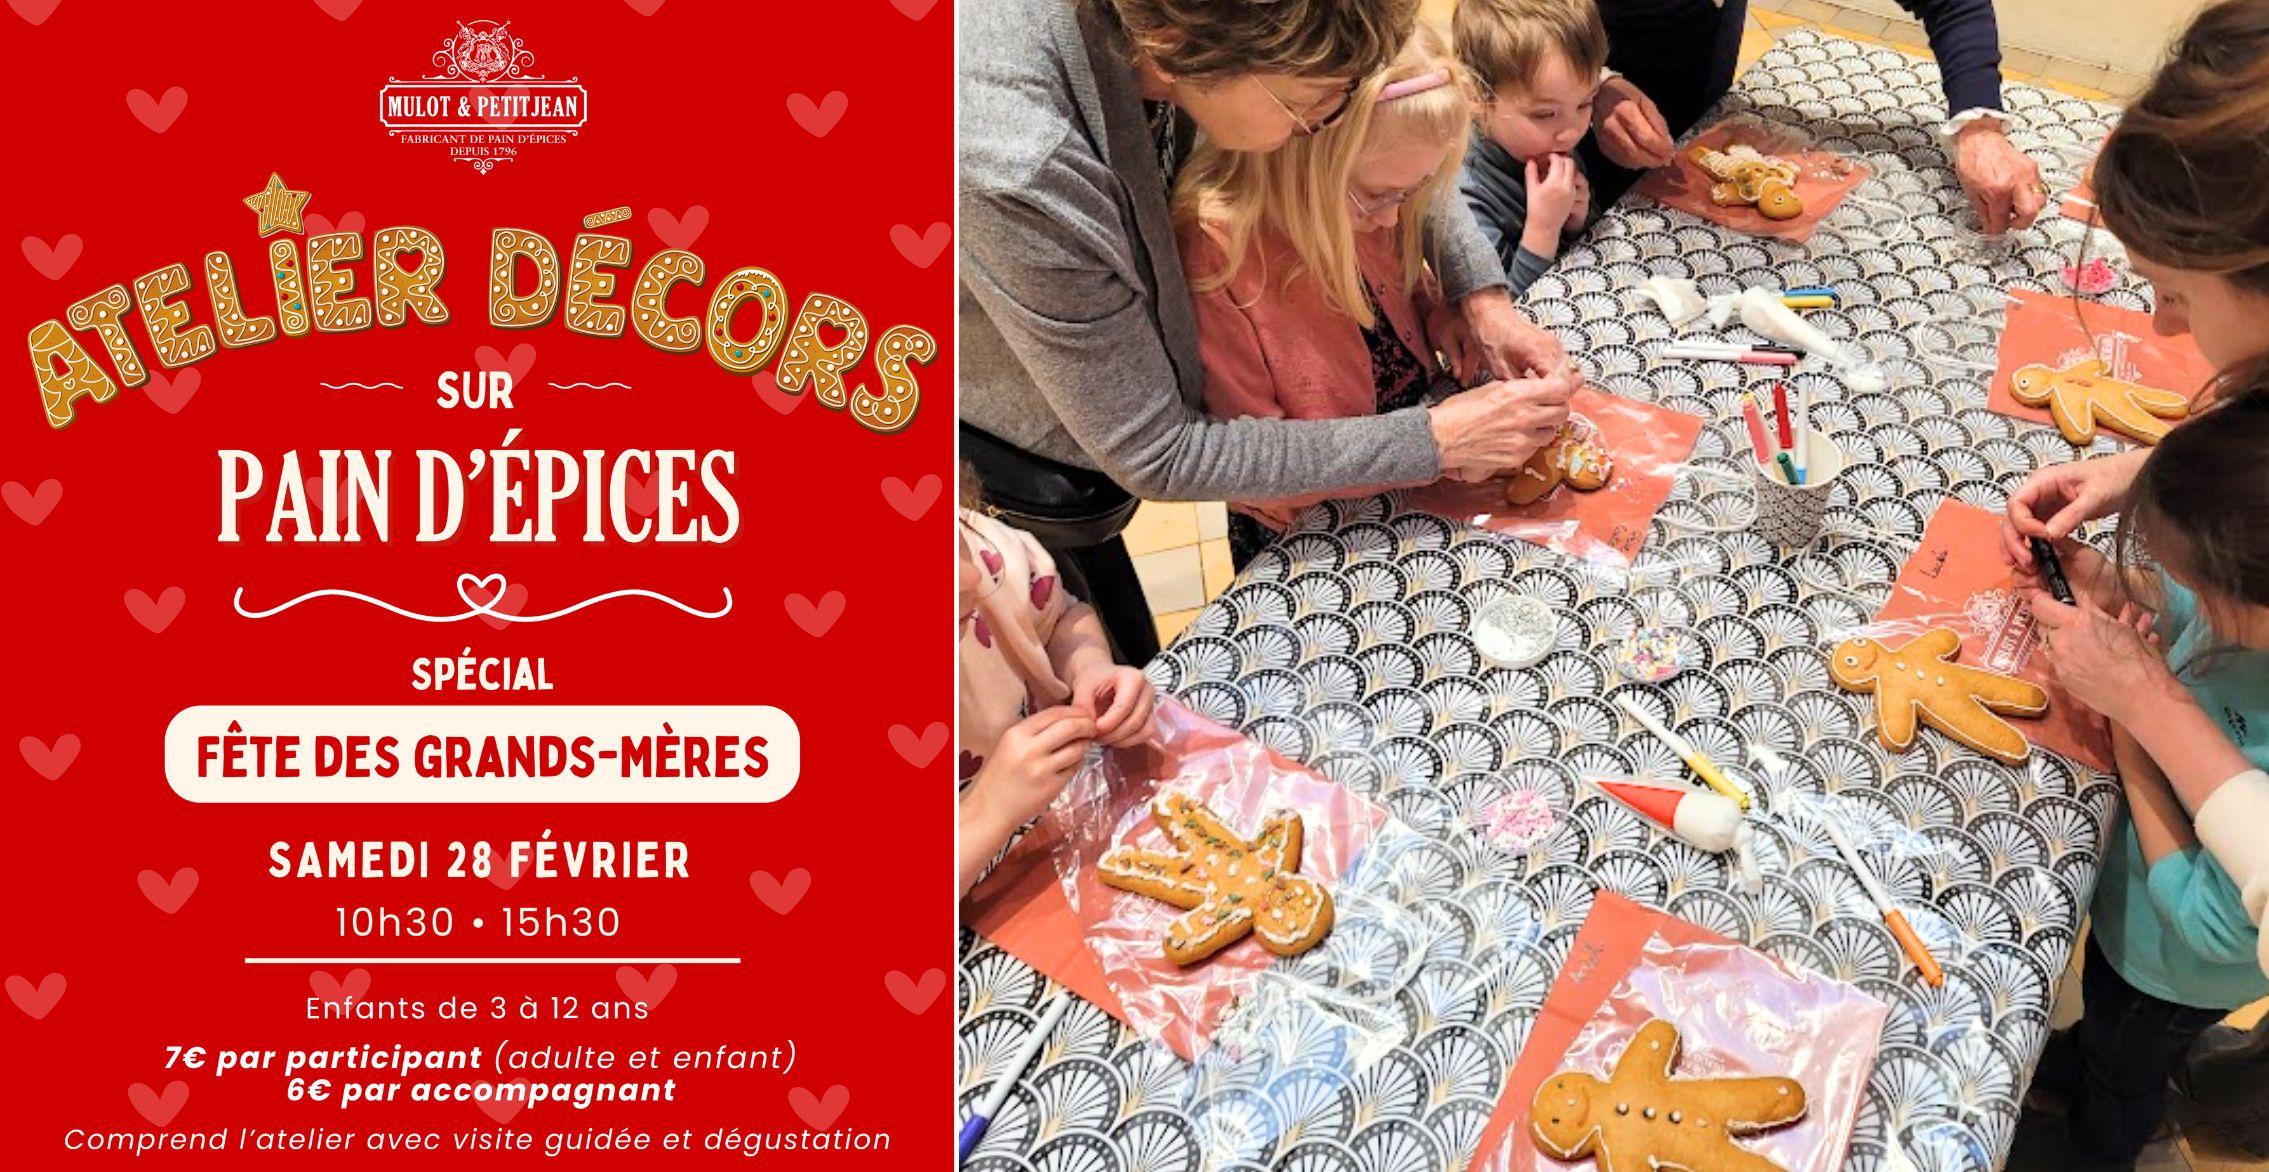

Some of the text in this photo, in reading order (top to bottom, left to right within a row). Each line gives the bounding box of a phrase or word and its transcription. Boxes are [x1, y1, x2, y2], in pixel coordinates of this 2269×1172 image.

[388, 96, 578, 117] MULOT & PETITJEAN
[401, 135, 467, 144] FABRICANT
[470, 135, 485, 144] DE
[488, 135, 514, 144] PAIN
[450, 147, 517, 156] DEPUIS 1796
[27, 172, 938, 432] ATELIER DÉCORS
[437, 371, 514, 409] SUR
[217, 428, 740, 544] PAIN D’ÉPICES
[411, 647, 554, 691] SPÉCIAL
[198, 720, 769, 779] FÊTE DES GRANDS-MÈRES
[269, 829, 689, 878] SAMEDI 28 FÉVRIER
[336, 907, 619, 937] 10h30 15h30
[307, 995, 648, 1020] Enfants de 3 à 12 ans
[164, 1040, 796, 1075] 7€ par participant (adulte et enfant)
[287, 1078, 676, 1109] 6€ par accompagnant
[64, 1127, 890, 1157] Comprend l’atelier avec visite guidée et dégustation
